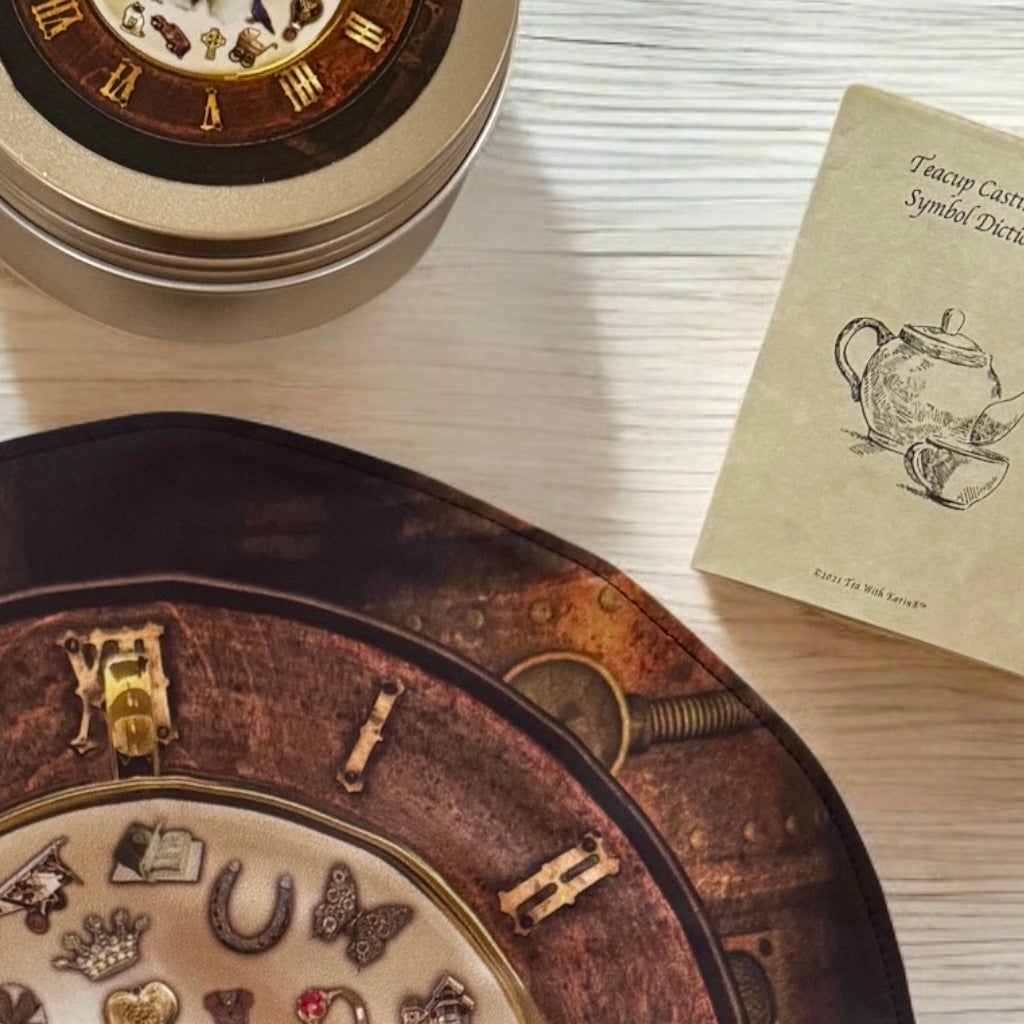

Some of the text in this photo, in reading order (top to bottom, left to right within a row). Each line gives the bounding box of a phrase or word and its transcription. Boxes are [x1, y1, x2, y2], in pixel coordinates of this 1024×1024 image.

[909, 154, 1024, 211] Teacup Casti
[904, 189, 982, 226] Symbol
[845, 577, 861, 590] Tea
[863, 583, 887, 598] With
